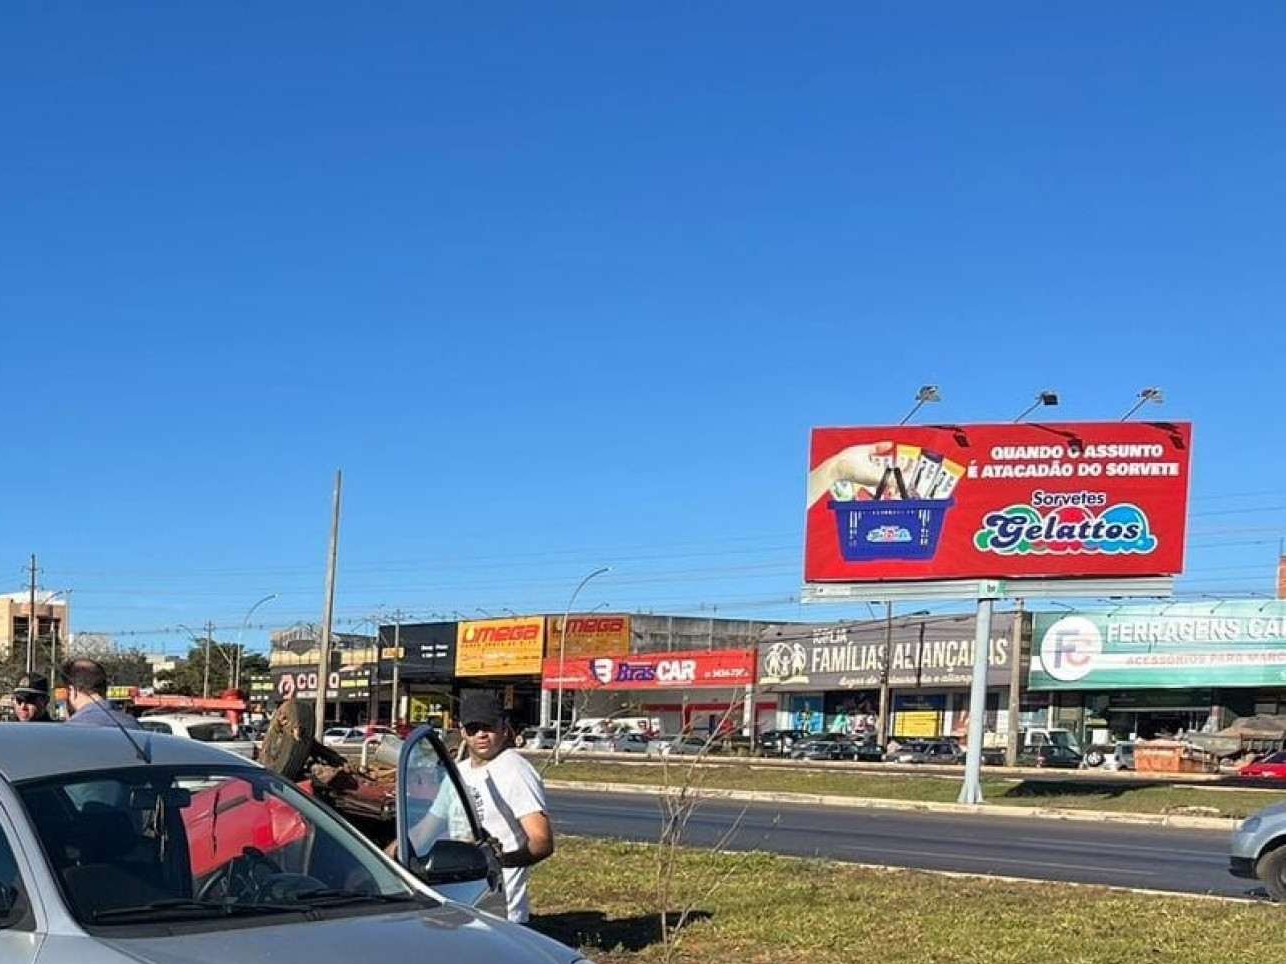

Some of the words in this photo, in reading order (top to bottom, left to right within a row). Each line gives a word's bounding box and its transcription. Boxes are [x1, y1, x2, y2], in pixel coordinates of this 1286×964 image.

[990, 447, 1063, 460] QUANDO
[1084, 444, 1163, 458] ASSUNTO
[967, 461, 978, 478] É
[981, 463, 1073, 478] ATACADÃO
[1077, 463, 1101, 477] DO
[1105, 462, 1179, 477] SORVETE
[1032, 491, 1106, 506] Sorvetes
[985, 514, 1140, 549] Gelattos
[1106, 618, 1240, 643] FERRAGENS
[811, 641, 889, 673] FAMÍLIAS
